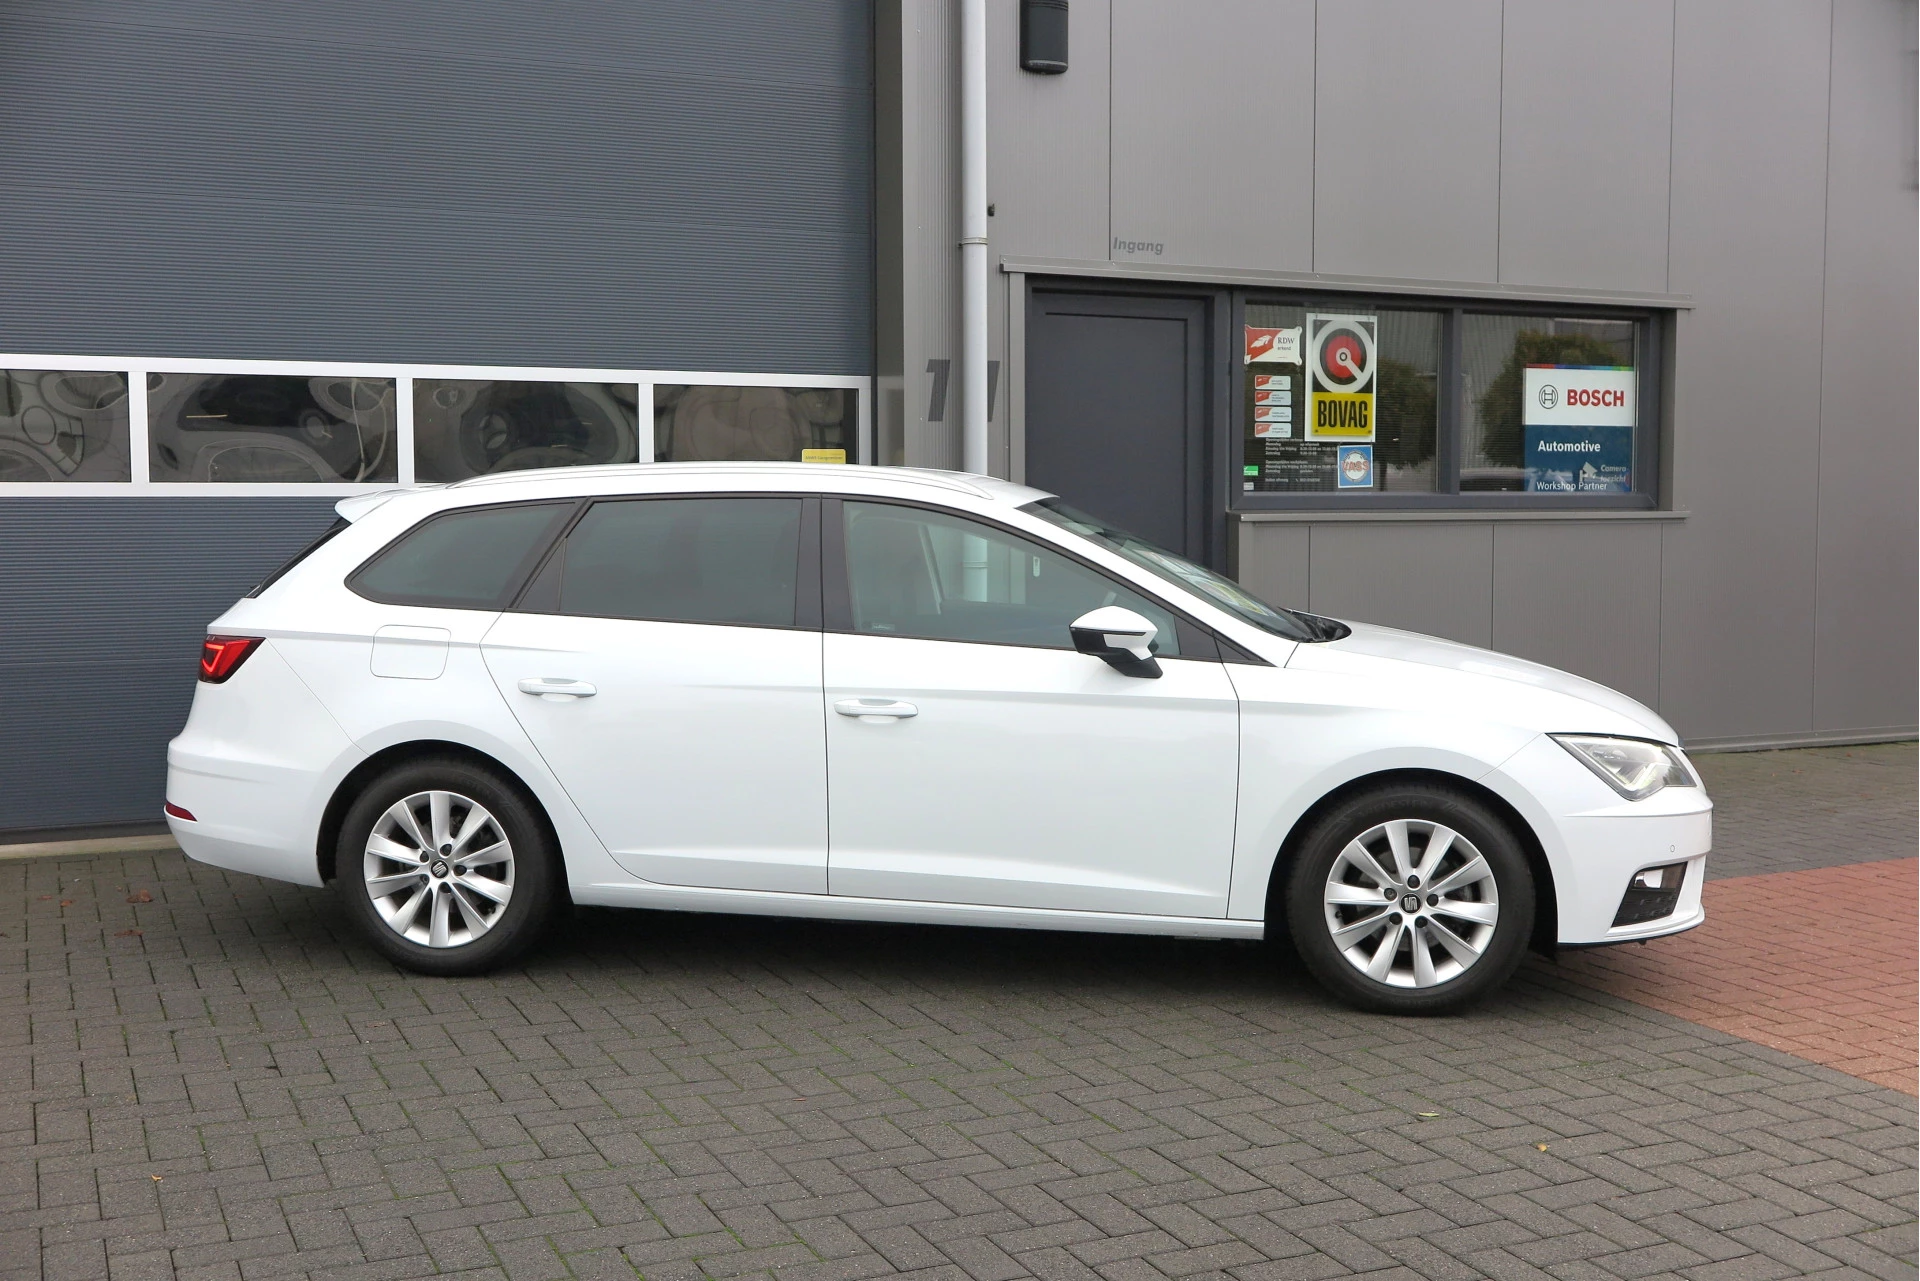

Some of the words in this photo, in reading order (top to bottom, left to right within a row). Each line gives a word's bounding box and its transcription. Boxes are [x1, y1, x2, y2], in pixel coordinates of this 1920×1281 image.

[1113, 236, 1164, 256] Ingang
[1277, 336, 1295, 344] RDW
[1567, 389, 1625, 407] BOSCH
[1318, 400, 1368, 428] BOVAG
[1538, 440, 1601, 452] Automotive
[1342, 461, 1370, 472] VASS
[1601, 464, 1627, 472] Camera
[1537, 481, 1576, 491] Workshop
[1578, 481, 1608, 490] Partner
